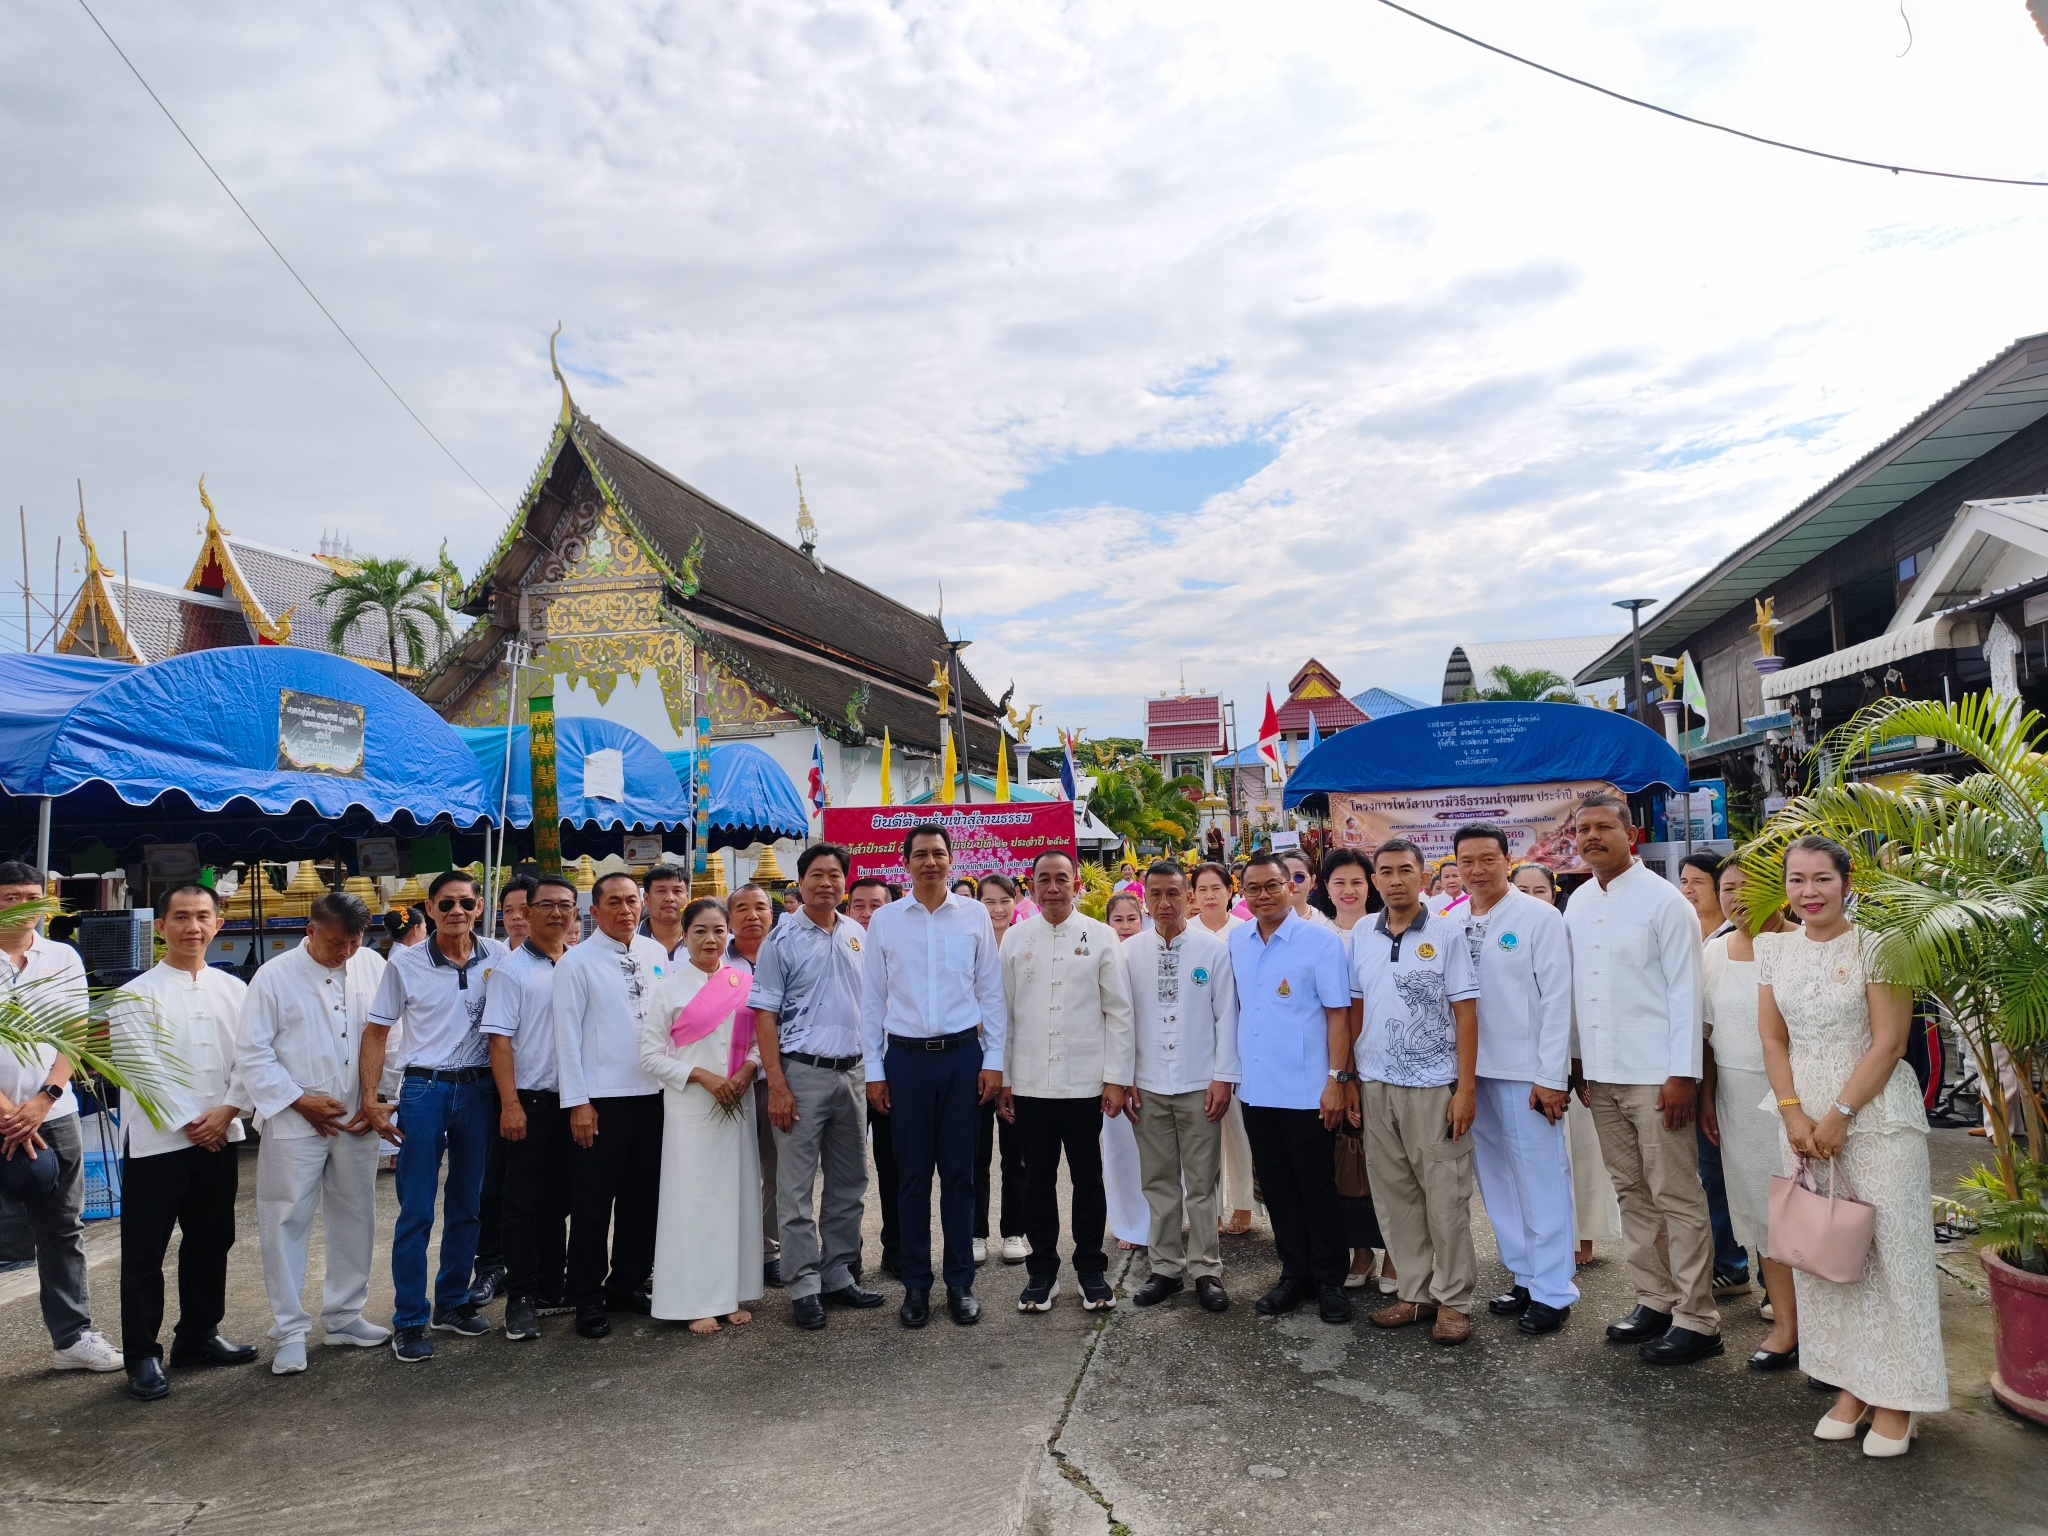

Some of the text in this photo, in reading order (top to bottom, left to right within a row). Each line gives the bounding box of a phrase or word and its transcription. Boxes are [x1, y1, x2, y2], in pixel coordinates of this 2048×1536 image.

[1537, 788, 1572, 801] ประจำปี
[872, 811, 1032, 829] ยินดีต้อนรับเข้าสู่ลานธรรม
[1010, 834, 1046, 847] ประจำปี
[1434, 835, 1445, 843] 11
[857, 865, 872, 877] โดย
